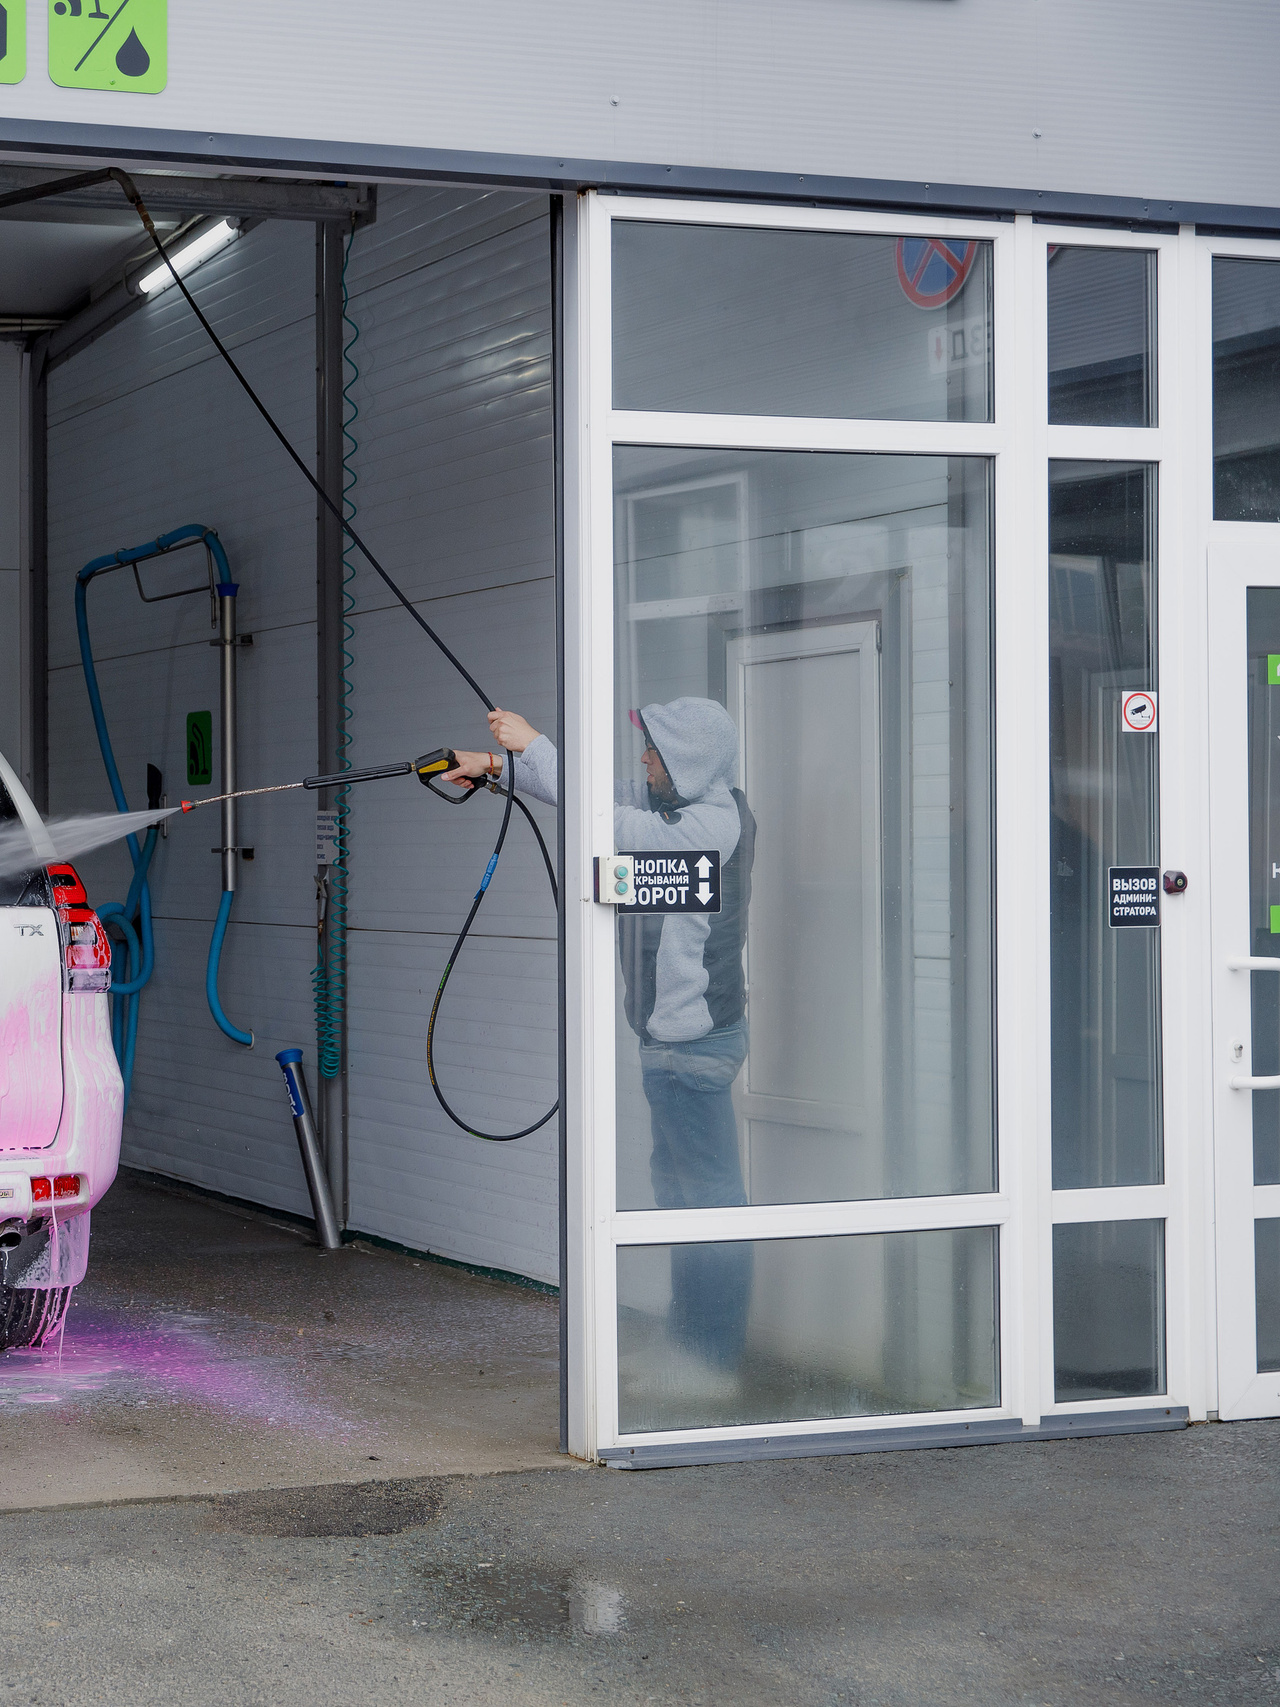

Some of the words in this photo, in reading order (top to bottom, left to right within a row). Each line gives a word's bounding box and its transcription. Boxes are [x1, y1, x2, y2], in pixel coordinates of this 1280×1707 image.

[634, 858, 689, 874] НОПКА
[634, 875, 689, 885] КРЫВАНИЯ
[1113, 878, 1157, 891] ВЫЗОВ
[1113, 893, 1157, 905] АДМИНИ-
[1113, 906, 1157, 916] СТРАТОРА
[13, 923, 44, 937] TX
